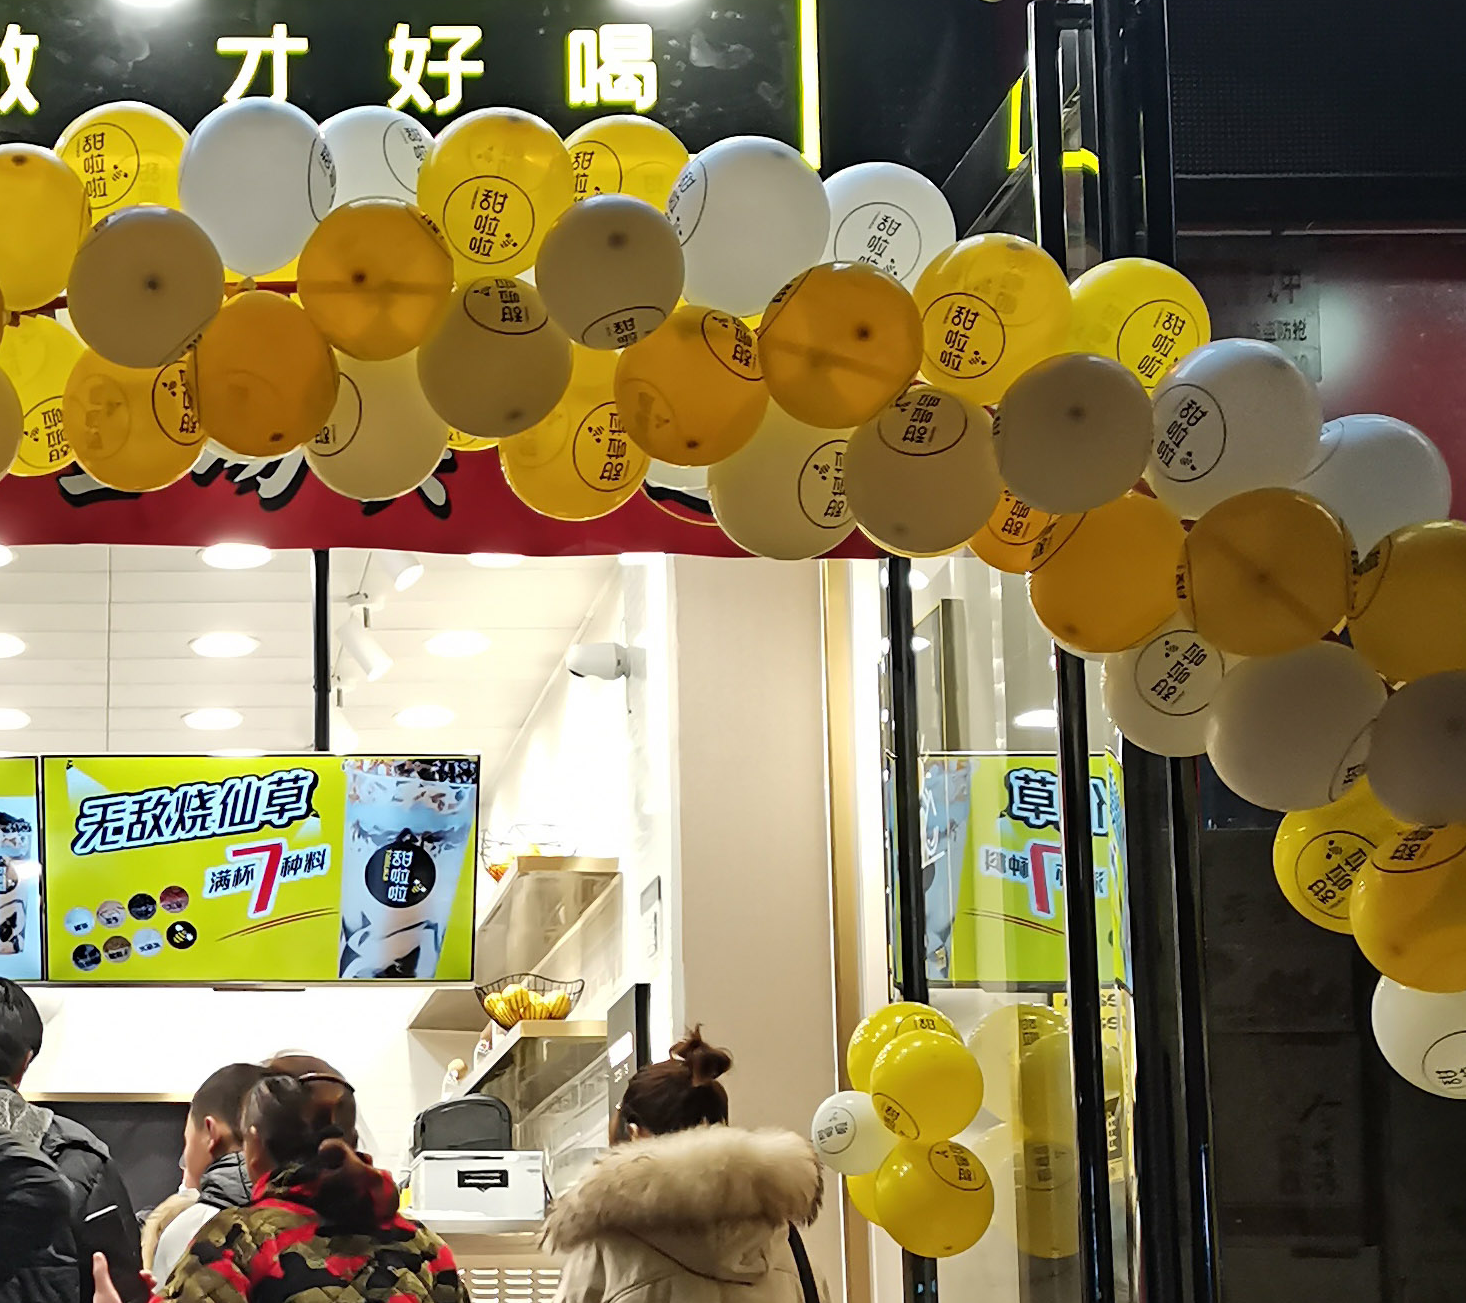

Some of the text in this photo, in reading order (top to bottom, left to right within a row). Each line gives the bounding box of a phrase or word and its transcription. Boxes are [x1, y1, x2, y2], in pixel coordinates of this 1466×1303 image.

[82, 131, 109, 199] 甜啦啦
[468, 188, 508, 258] 甜啦啦
[938, 304, 980, 372] 甜啦啦
[1137, 310, 1186, 379] 甜啦啦
[1156, 398, 1209, 468] 甜啦啦
[1150, 641, 1208, 702] 甜啦啦
[78, 769, 314, 853] 无敌烧仙草
